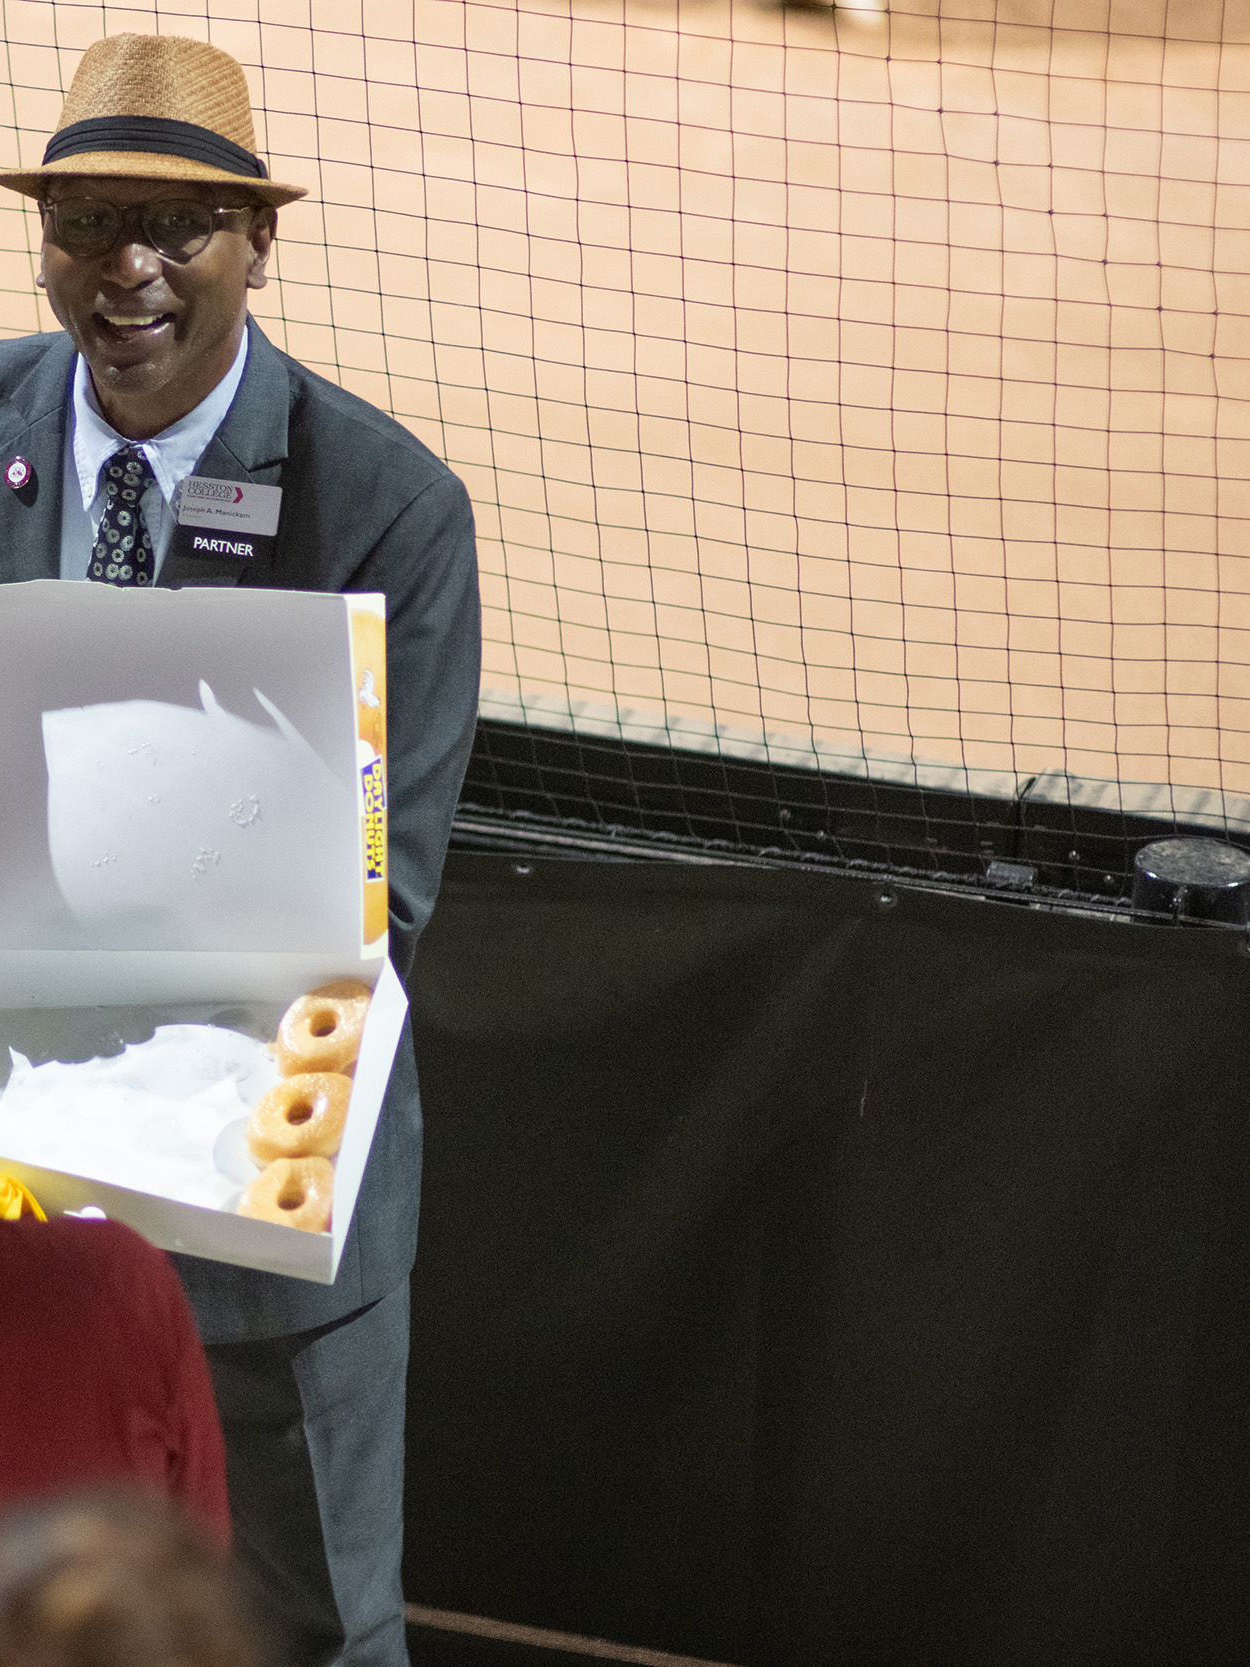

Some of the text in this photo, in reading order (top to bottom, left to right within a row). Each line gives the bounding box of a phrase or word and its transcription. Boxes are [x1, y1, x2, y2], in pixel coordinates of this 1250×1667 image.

[187, 487, 232, 499] COLLEGE
[188, 481, 233, 492] HESSTON
[183, 505, 205, 513] Joseph
[193, 537, 253, 557] PARTNER
[363, 774, 376, 871] DONUTS
[372, 763, 384, 877] DAYLIGHT
